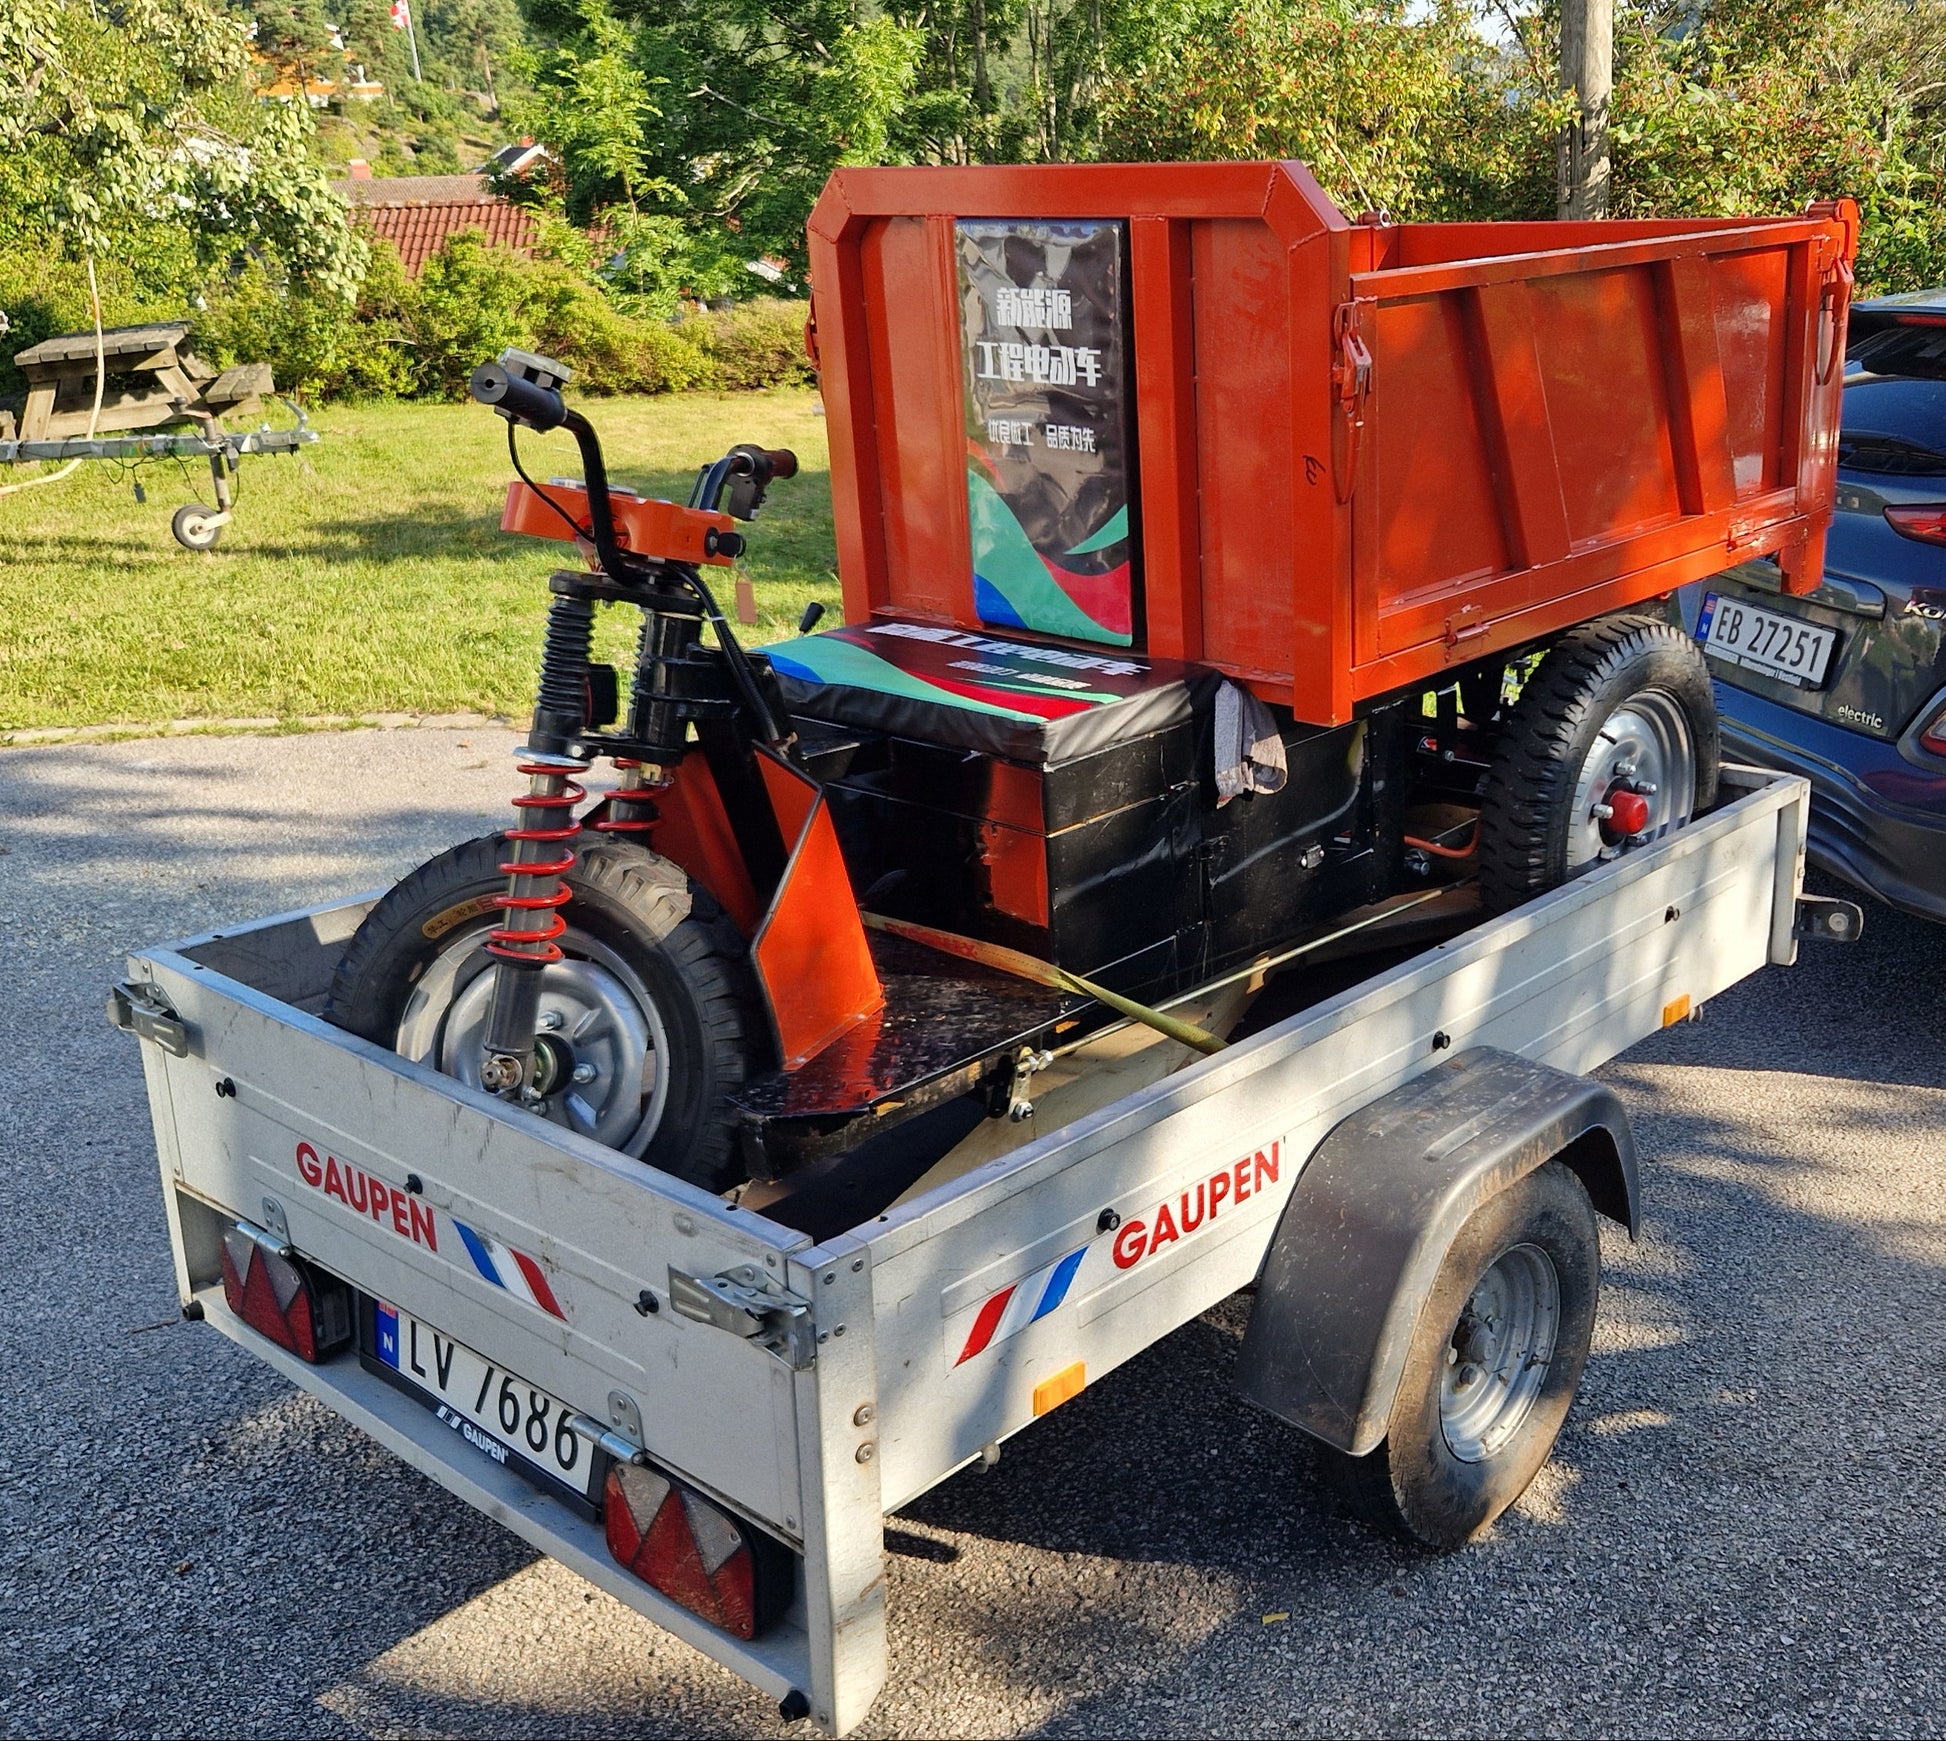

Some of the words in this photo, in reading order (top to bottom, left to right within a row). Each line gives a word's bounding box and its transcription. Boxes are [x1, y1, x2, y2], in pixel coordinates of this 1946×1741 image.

[996, 287, 1073, 329] 新能源
[976, 342, 1102, 387] 工程电动车
[1045, 424, 1096, 453] 品质为先
[1903, 600, 1946, 619] KO
[1715, 606, 1743, 645] EB
[1747, 616, 1823, 673] 27251
[1838, 704, 1883, 729] electric
[296, 1142, 437, 1252] GAUPEN
[1112, 1140, 1280, 1270] GAUPEN
[383, 1331, 394, 1353] N
[410, 1320, 454, 1391] LV
[463, 1422, 507, 1465] GAUPEN
